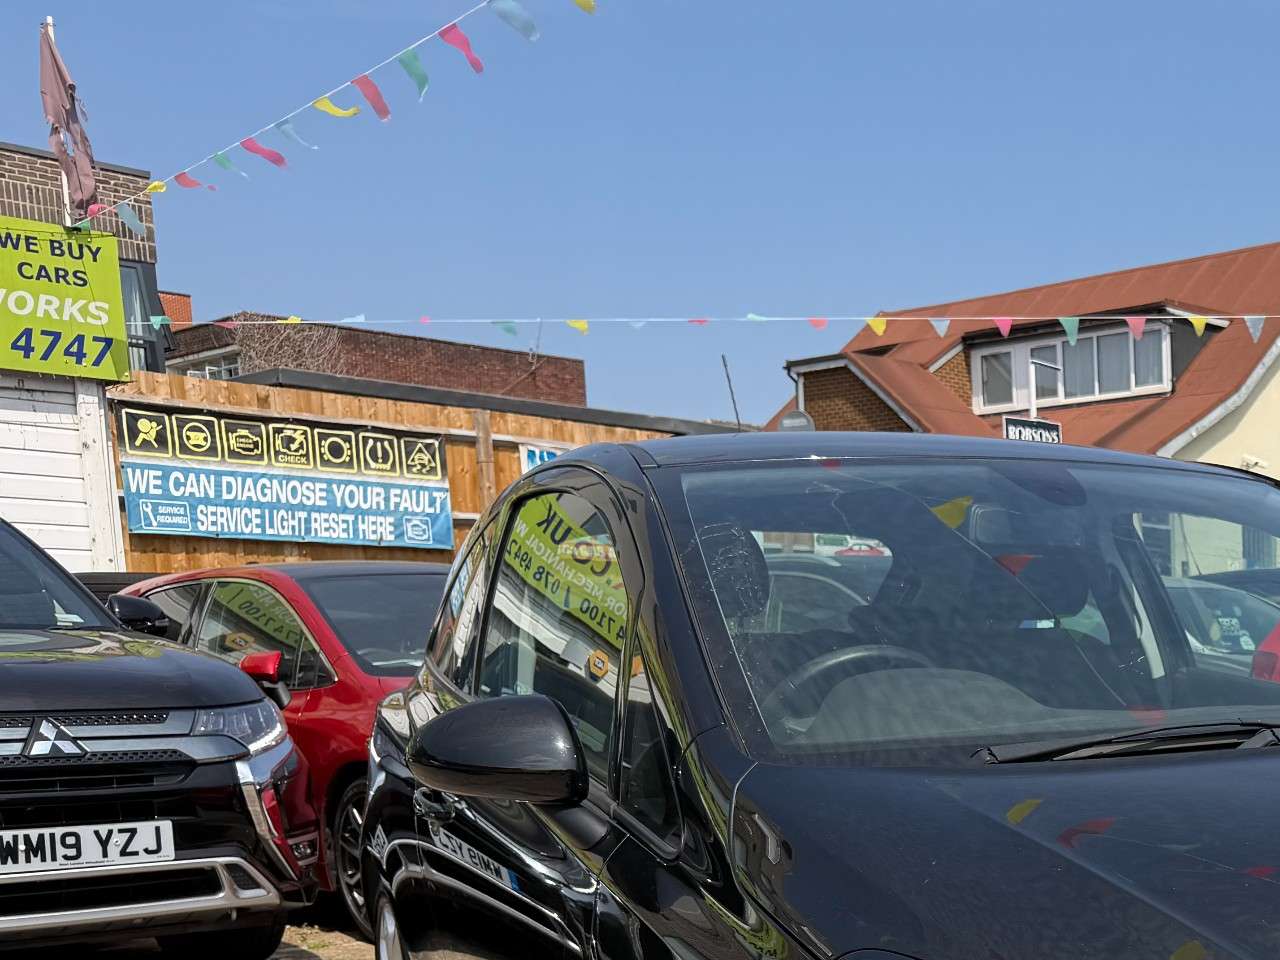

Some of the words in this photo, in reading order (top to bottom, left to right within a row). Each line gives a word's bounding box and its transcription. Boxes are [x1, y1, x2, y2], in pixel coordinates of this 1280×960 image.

[0, 232, 40, 254] WE
[49, 239, 102, 262] BUY
[17, 262, 89, 287] CARS
[10, 328, 114, 367] 4747
[278, 455, 308, 464] CHECK
[126, 468, 163, 495] WE
[168, 471, 215, 499] CAN
[222, 476, 328, 506] DIAGNOSE
[332, 484, 385, 510] YOUR
[389, 489, 443, 514] FAULT
[157, 505, 185, 515] SERVICE
[157, 515, 188, 525] REQUIRED
[196, 505, 261, 534] SERVICE
[265, 508, 308, 536] LIGHT
[311, 512, 355, 539] RESET
[358, 515, 395, 541] HERE
[0, 831, 82, 866] WM19
[93, 825, 163, 859] YZJ
